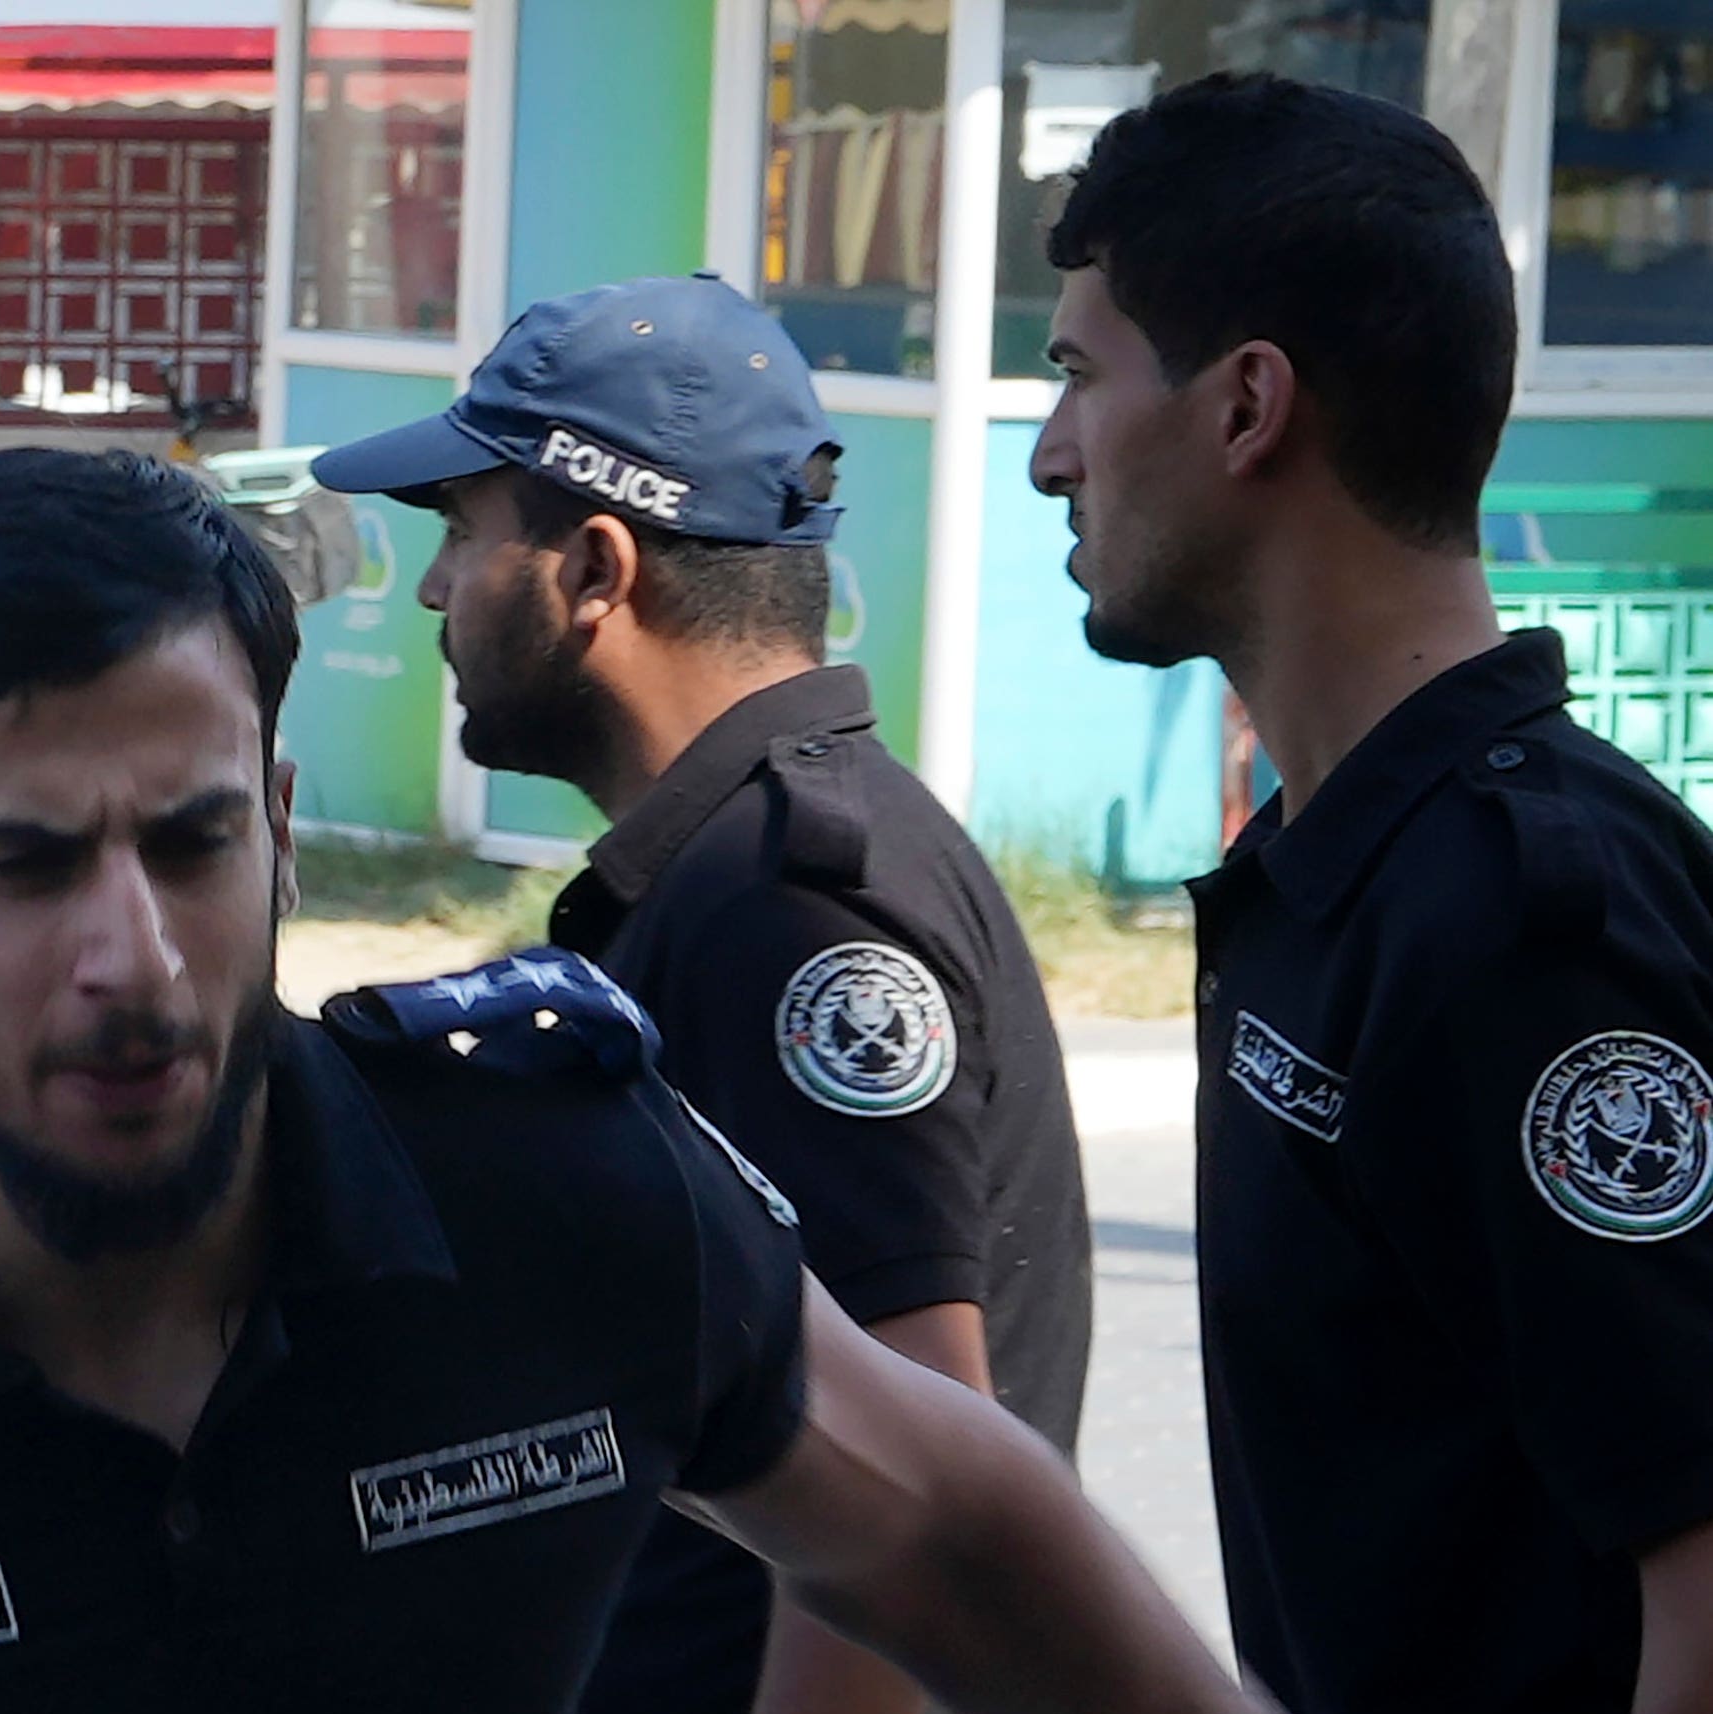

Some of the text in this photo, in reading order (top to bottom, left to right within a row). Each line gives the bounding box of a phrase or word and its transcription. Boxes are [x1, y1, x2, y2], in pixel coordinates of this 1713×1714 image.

[540, 430, 690, 519] POLICE
[367, 1425, 613, 1532] الشرطة الفلسطينية
